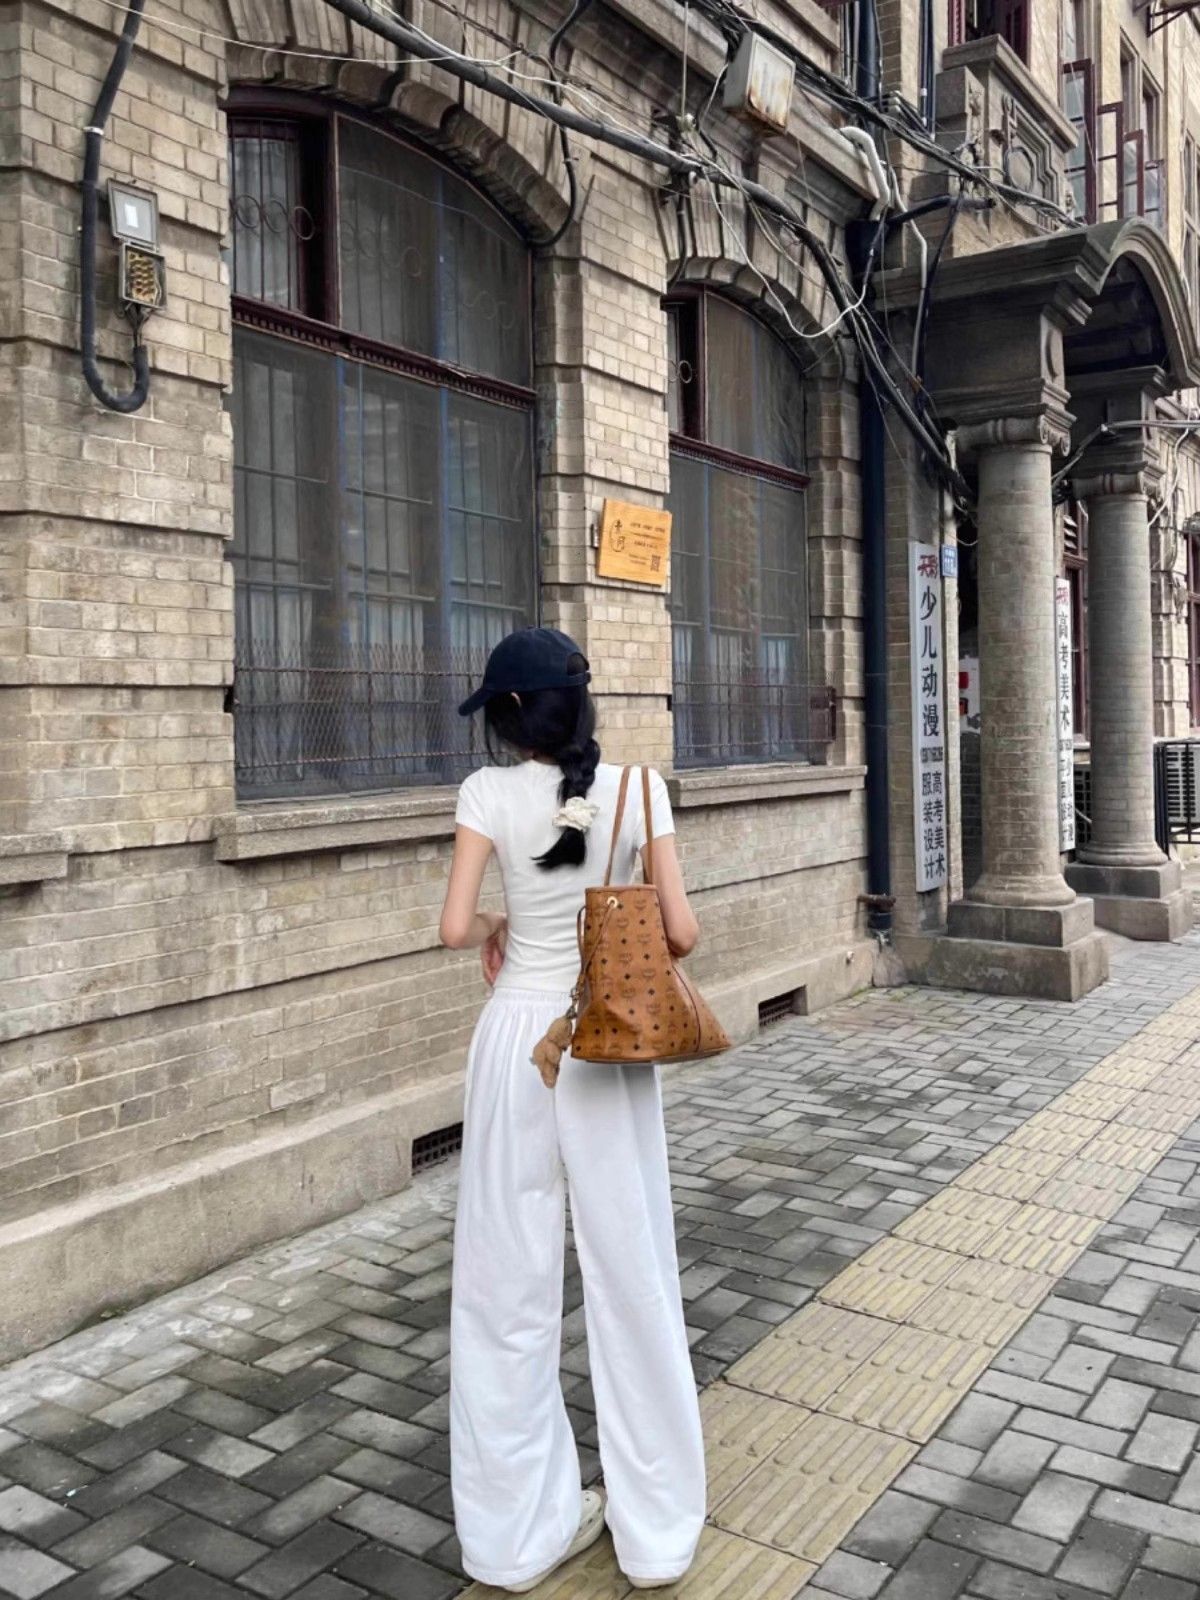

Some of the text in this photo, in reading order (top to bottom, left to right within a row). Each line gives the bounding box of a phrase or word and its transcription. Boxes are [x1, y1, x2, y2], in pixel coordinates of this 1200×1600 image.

[921, 585, 939, 736] 少儿动漫
[1057, 611, 1070, 731] 高考美术
[922, 771, 935, 879] 服装设计
[932, 770, 945, 877] 高考美术
